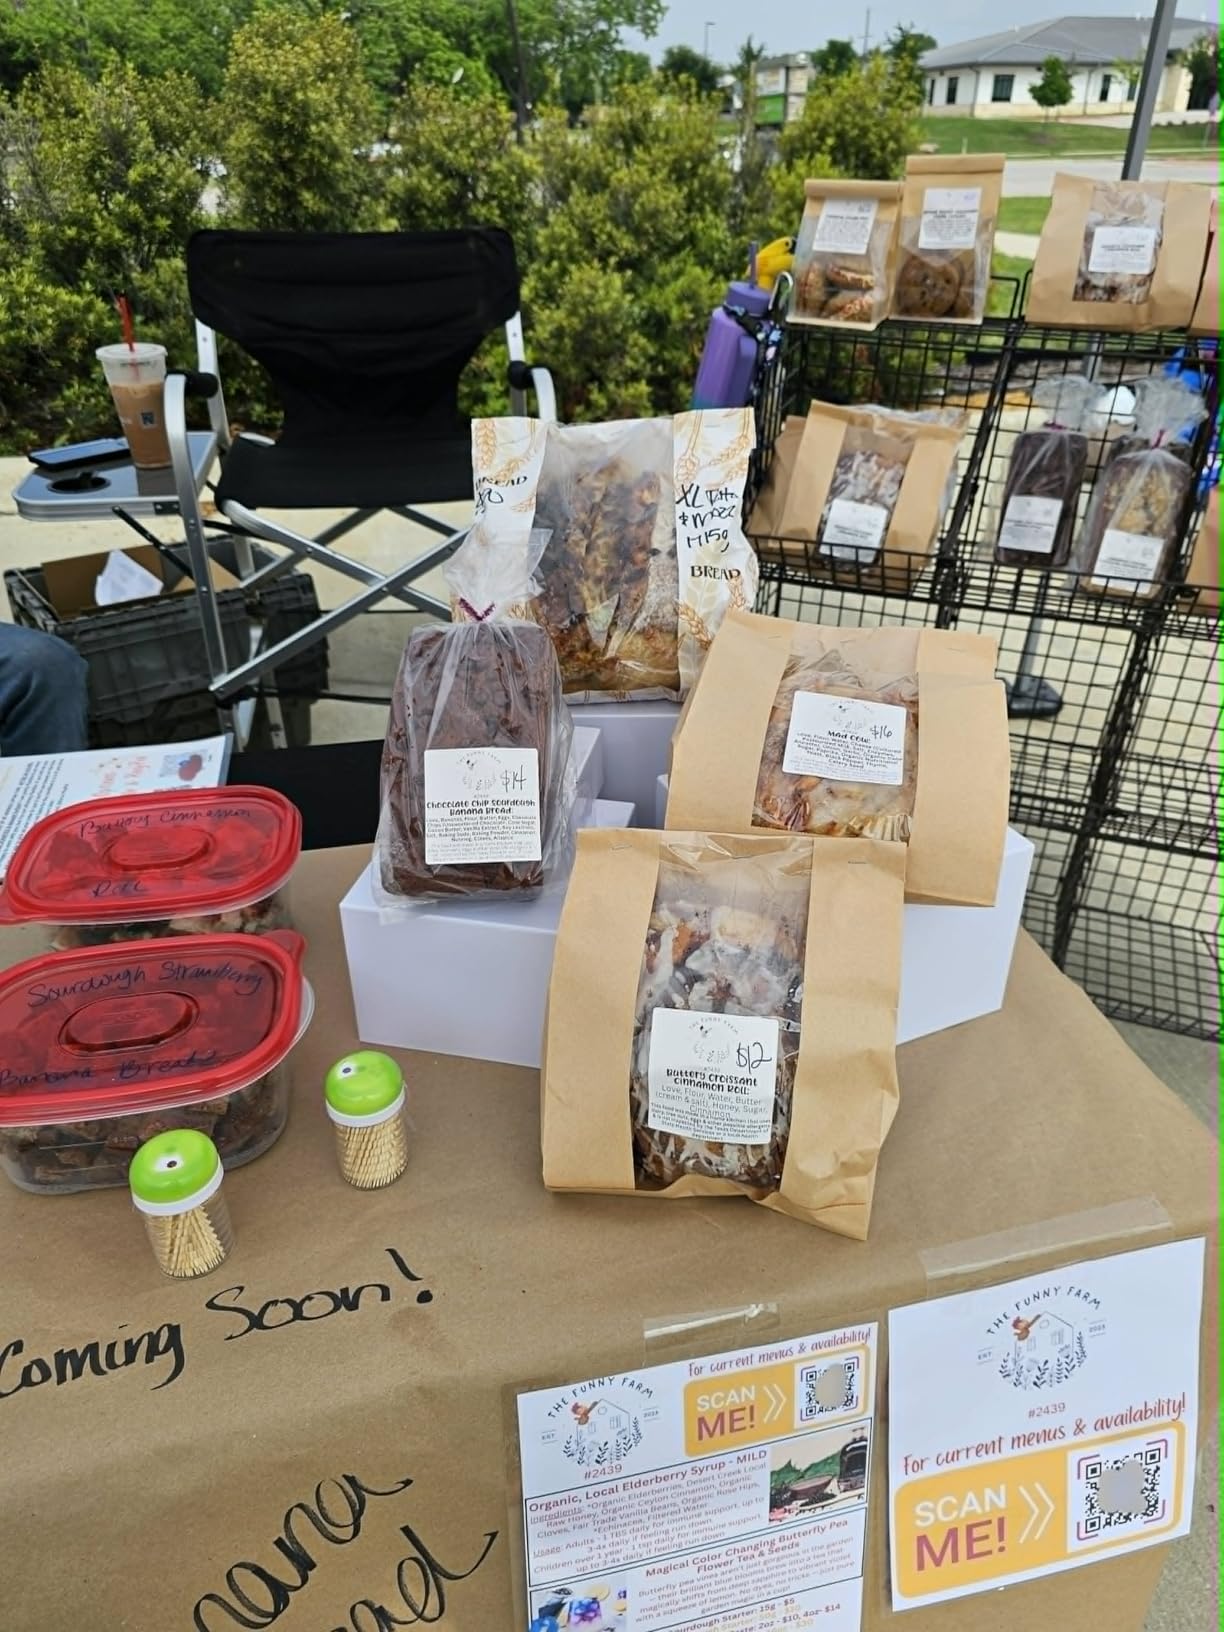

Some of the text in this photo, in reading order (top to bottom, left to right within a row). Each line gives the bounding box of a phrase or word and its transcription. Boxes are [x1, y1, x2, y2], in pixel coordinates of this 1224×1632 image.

[691, 566, 741, 580] BREAD
[870, 724, 892, 739] $16
[736, 1042, 772, 1074] $12
[0, 1247, 433, 1399] Coming Soon!
[986, 1286, 1101, 1335] THE FUNNY FARM
[688, 1328, 871, 1376] For current menus & availability!
[548, 1377, 654, 1419] THE FUNNY FARM
[697, 1385, 755, 1412] SCAN
[1028, 1402, 1066, 1418] #2439
[697, 1405, 755, 1442] ME!
[903, 1391, 1186, 1475] For current menus & availability!
[529, 1493, 581, 1513] Organic,
[585, 1484, 618, 1500] Local
[623, 1470, 686, 1491] Elderberry
[691, 1461, 725, 1476] Syrup
[736, 1449, 766, 1464] MILD
[584, 1464, 622, 1481] #2439
[915, 1485, 1007, 1528] SCAN
[646, 1519, 847, 1576] Magical Color Changing Butterfly Pea
[697, 1540, 799, 1573] Flower Tea & Seeds
[916, 1516, 1006, 1571] ME!
[722, 1608, 758, 1622] Starter:
[760, 1603, 777, 1613] 15g
[824, 1603, 841, 1613] $14
